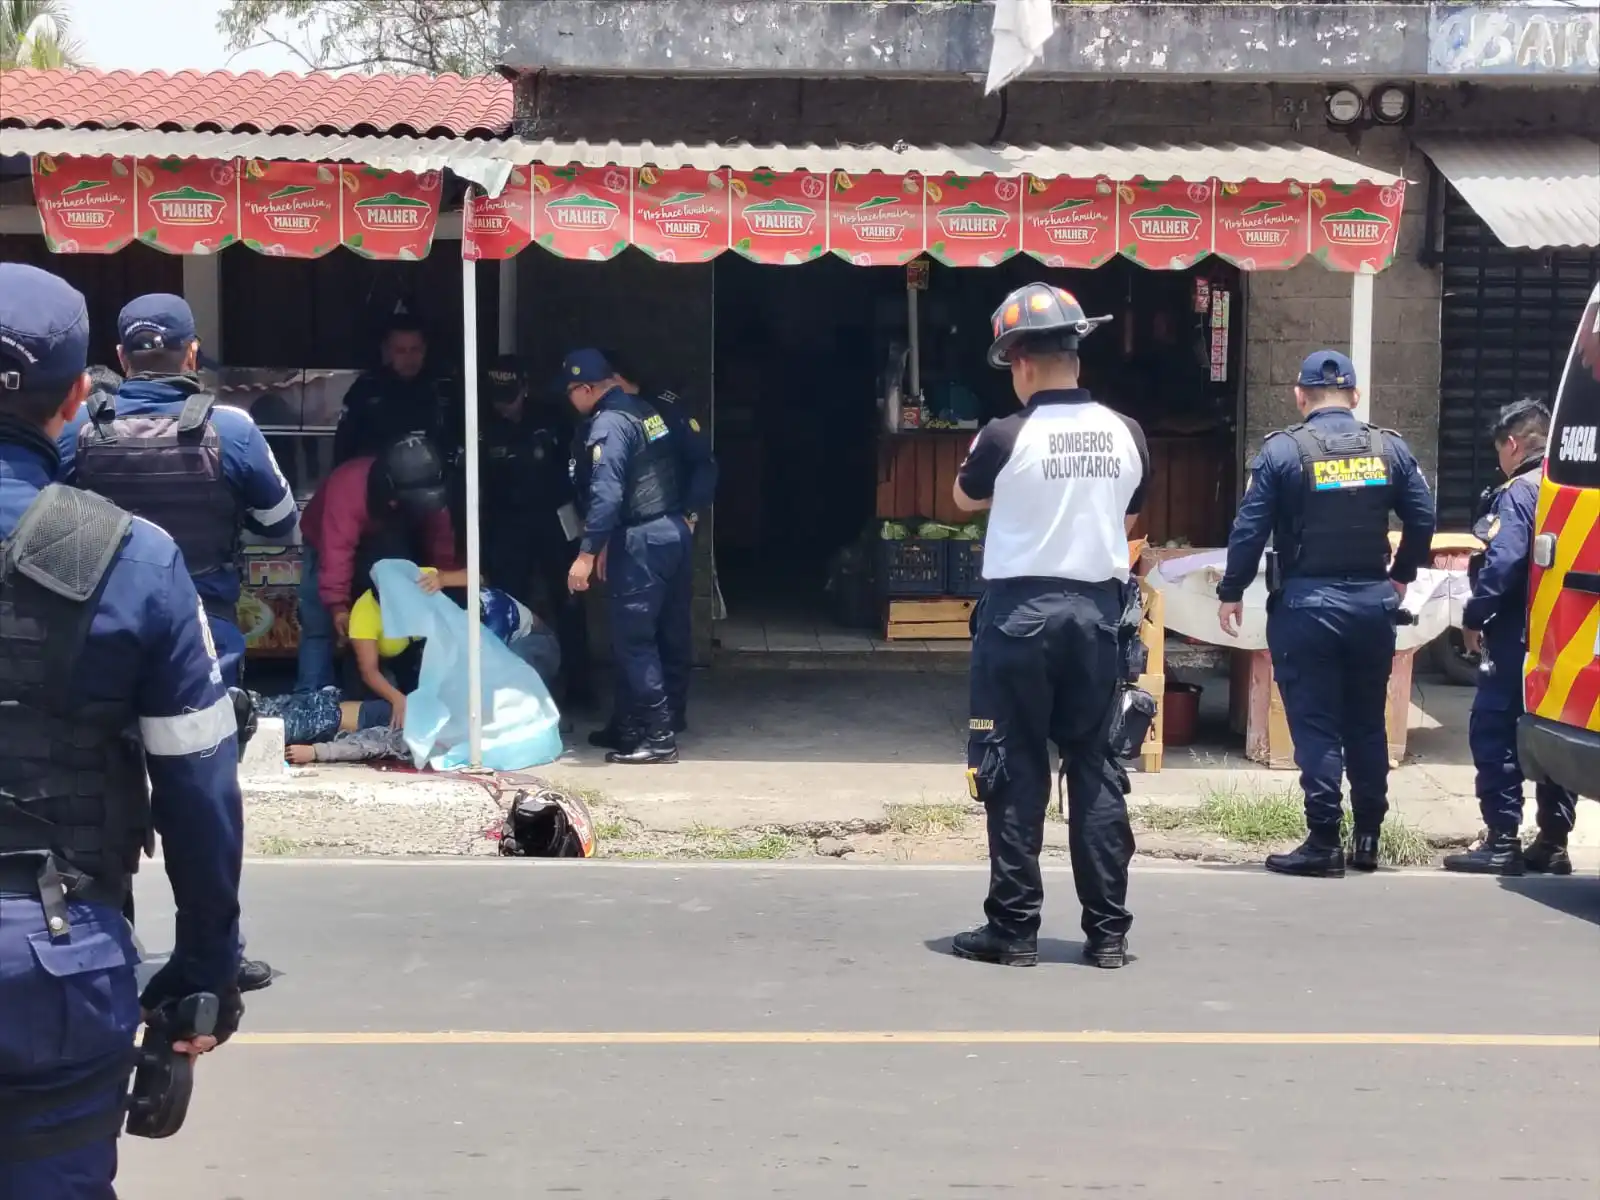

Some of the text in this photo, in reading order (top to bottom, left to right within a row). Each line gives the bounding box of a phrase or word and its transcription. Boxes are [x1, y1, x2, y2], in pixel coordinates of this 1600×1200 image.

[67, 212, 105, 223] MALHER
[161, 202, 213, 219] MALHER
[366, 207, 418, 225] MALHER
[557, 207, 608, 225] MALHER
[274, 216, 311, 228] MALHER
[665, 222, 701, 233] MALHER
[754, 214, 804, 230] MALHER
[949, 216, 998, 232] MALHER
[1140, 219, 1190, 235] MALHER
[861, 226, 896, 237] MALHER
[1054, 229, 1088, 239] MALHER
[1246, 231, 1280, 242] MALHER
[1332, 223, 1380, 240] MALHER
[1049, 431, 1114, 455] BOMBEROS
[1042, 455, 1121, 480] VOLUNTARIOS
[1313, 456, 1386, 476] POLICIA
[1316, 470, 1388, 484] NACIONAL CIVIL
